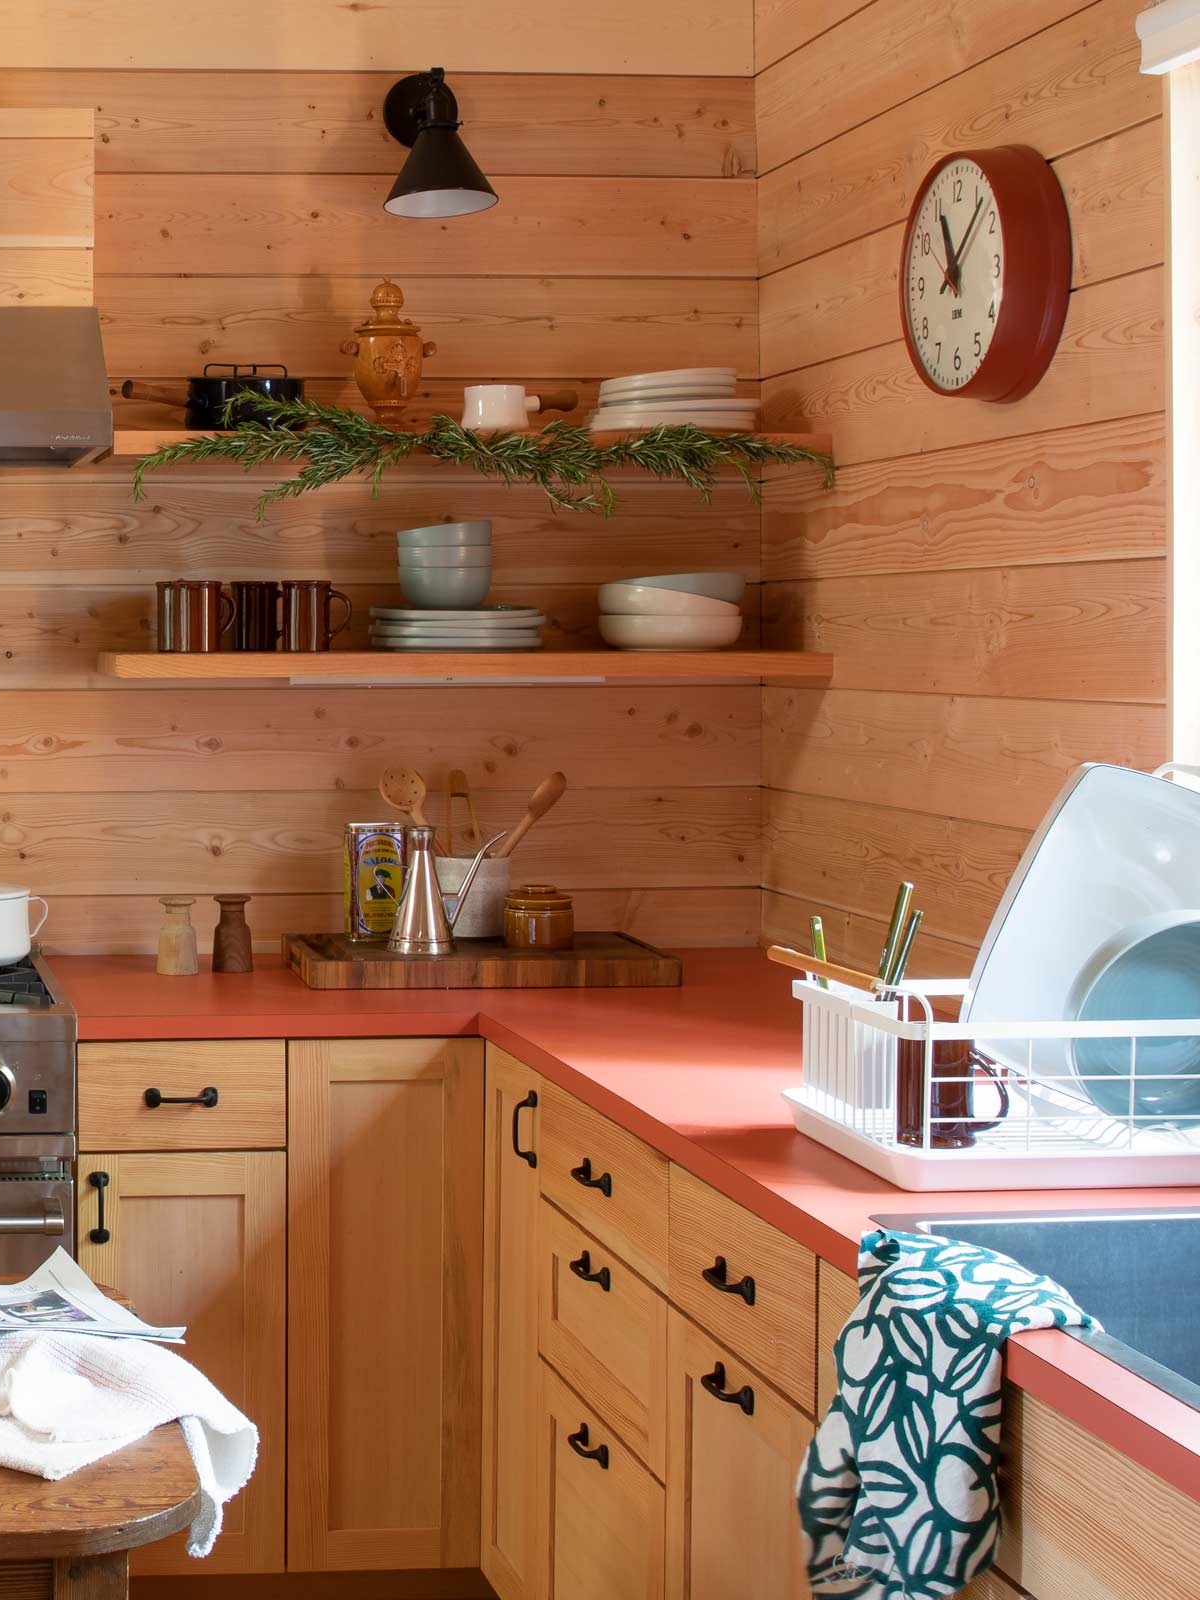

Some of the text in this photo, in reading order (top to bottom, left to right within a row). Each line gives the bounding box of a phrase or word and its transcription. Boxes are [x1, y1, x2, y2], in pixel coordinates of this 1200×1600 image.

[953, 179, 963, 204] 12
[934, 198, 942, 223] 11
[989, 210, 996, 234] 2
[921, 232, 931, 257] 10
[993, 254, 1001, 279] 3
[917, 276, 925, 300] 9
[988, 300, 996, 324] 4
[922, 316, 929, 340] 8
[935, 342, 942, 365] 7
[974, 332, 982, 357] 5
[953, 346, 962, 371] 6
